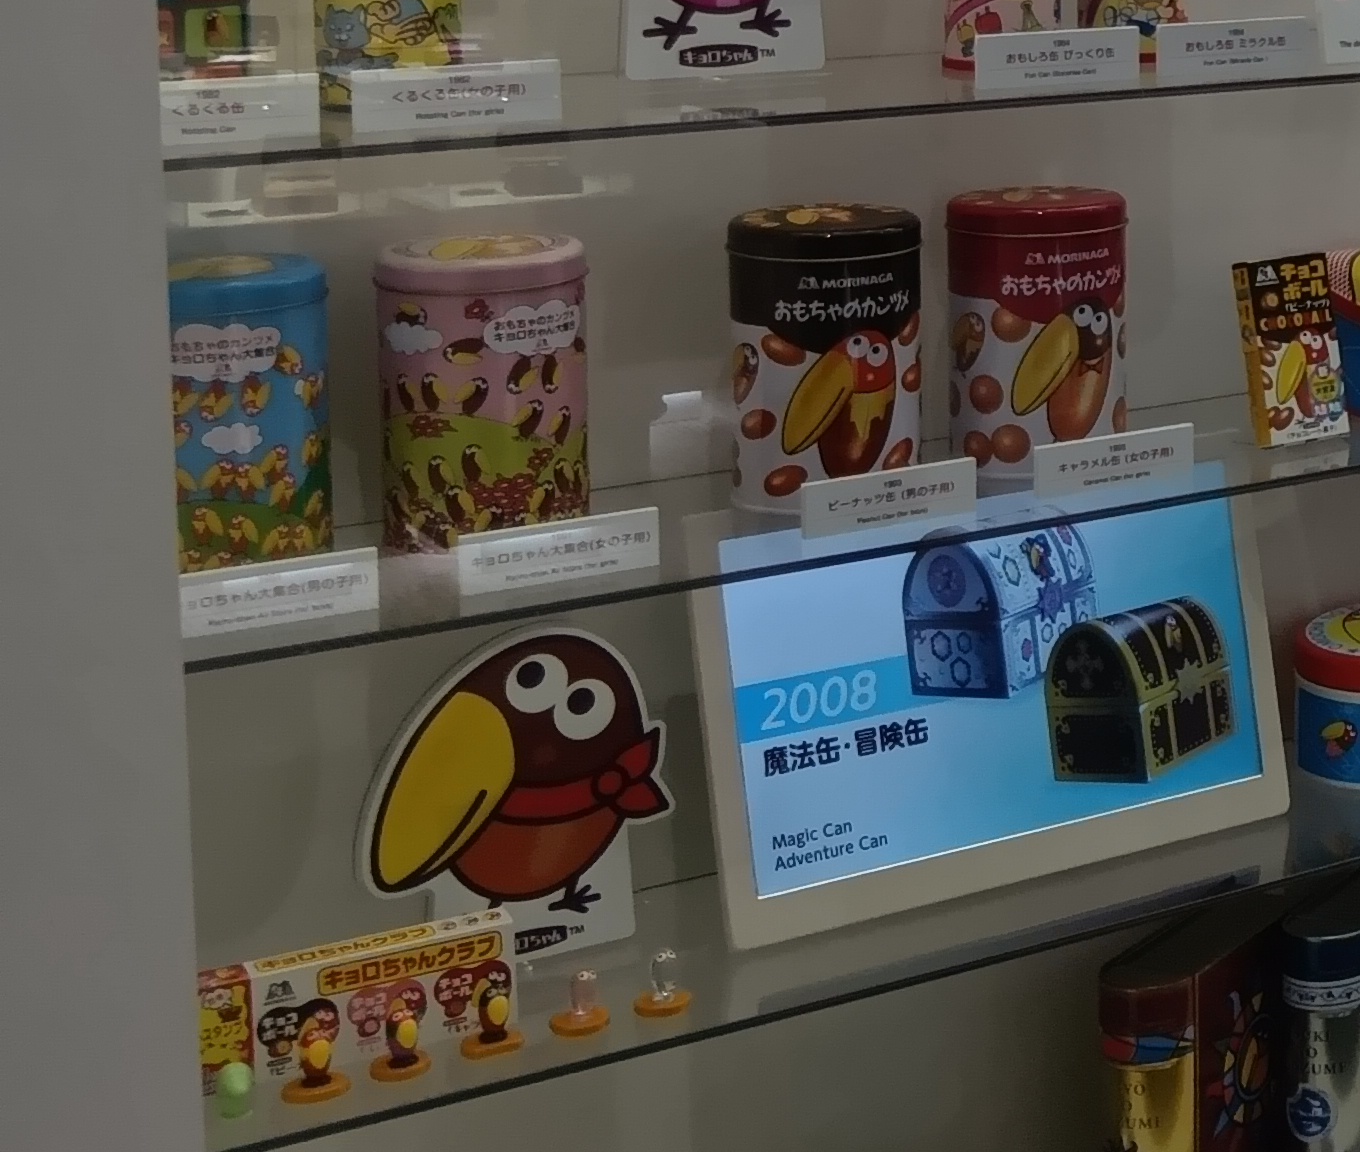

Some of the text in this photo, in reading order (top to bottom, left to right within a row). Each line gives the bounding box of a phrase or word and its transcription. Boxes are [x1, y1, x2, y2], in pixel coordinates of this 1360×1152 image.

[682, 47, 754, 64] キョロちゃん
[172, 102, 245, 116] くるくる缶
[1047, 248, 1109, 265] MORINAGA
[1280, 259, 1326, 281] チョコ
[822, 273, 894, 290] MORINAGA
[1282, 279, 1329, 301] ボール
[1058, 455, 1120, 473] キャラメル缶
[828, 490, 896, 511] ピーナッツ缶
[760, 669, 878, 731] 2008
[763, 716, 929, 777] 魔法缶・冒険缶
[772, 819, 853, 852] Magic Can
[774, 832, 888, 871] Adventure Can
